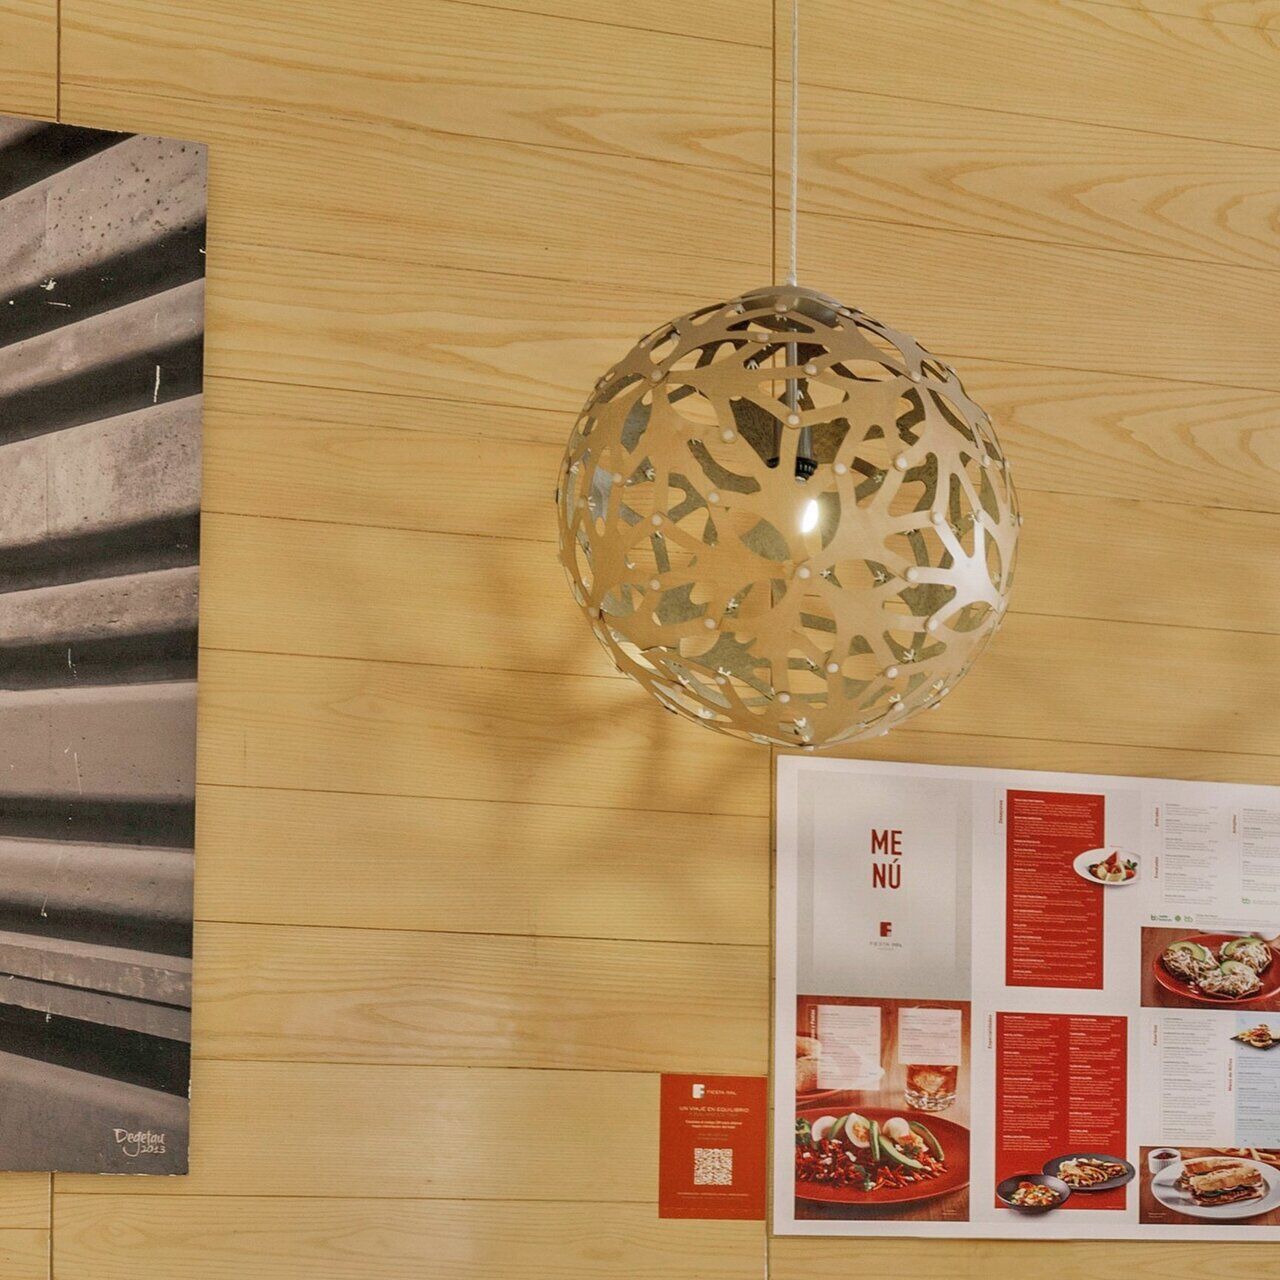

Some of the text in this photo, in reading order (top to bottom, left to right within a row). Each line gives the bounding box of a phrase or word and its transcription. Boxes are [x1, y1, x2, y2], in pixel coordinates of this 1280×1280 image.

[871, 829, 902, 856] ME
[872, 858, 901, 889] NÚ
[113, 1128, 166, 1157] Degetau
[140, 1145, 166, 1154] 2013
